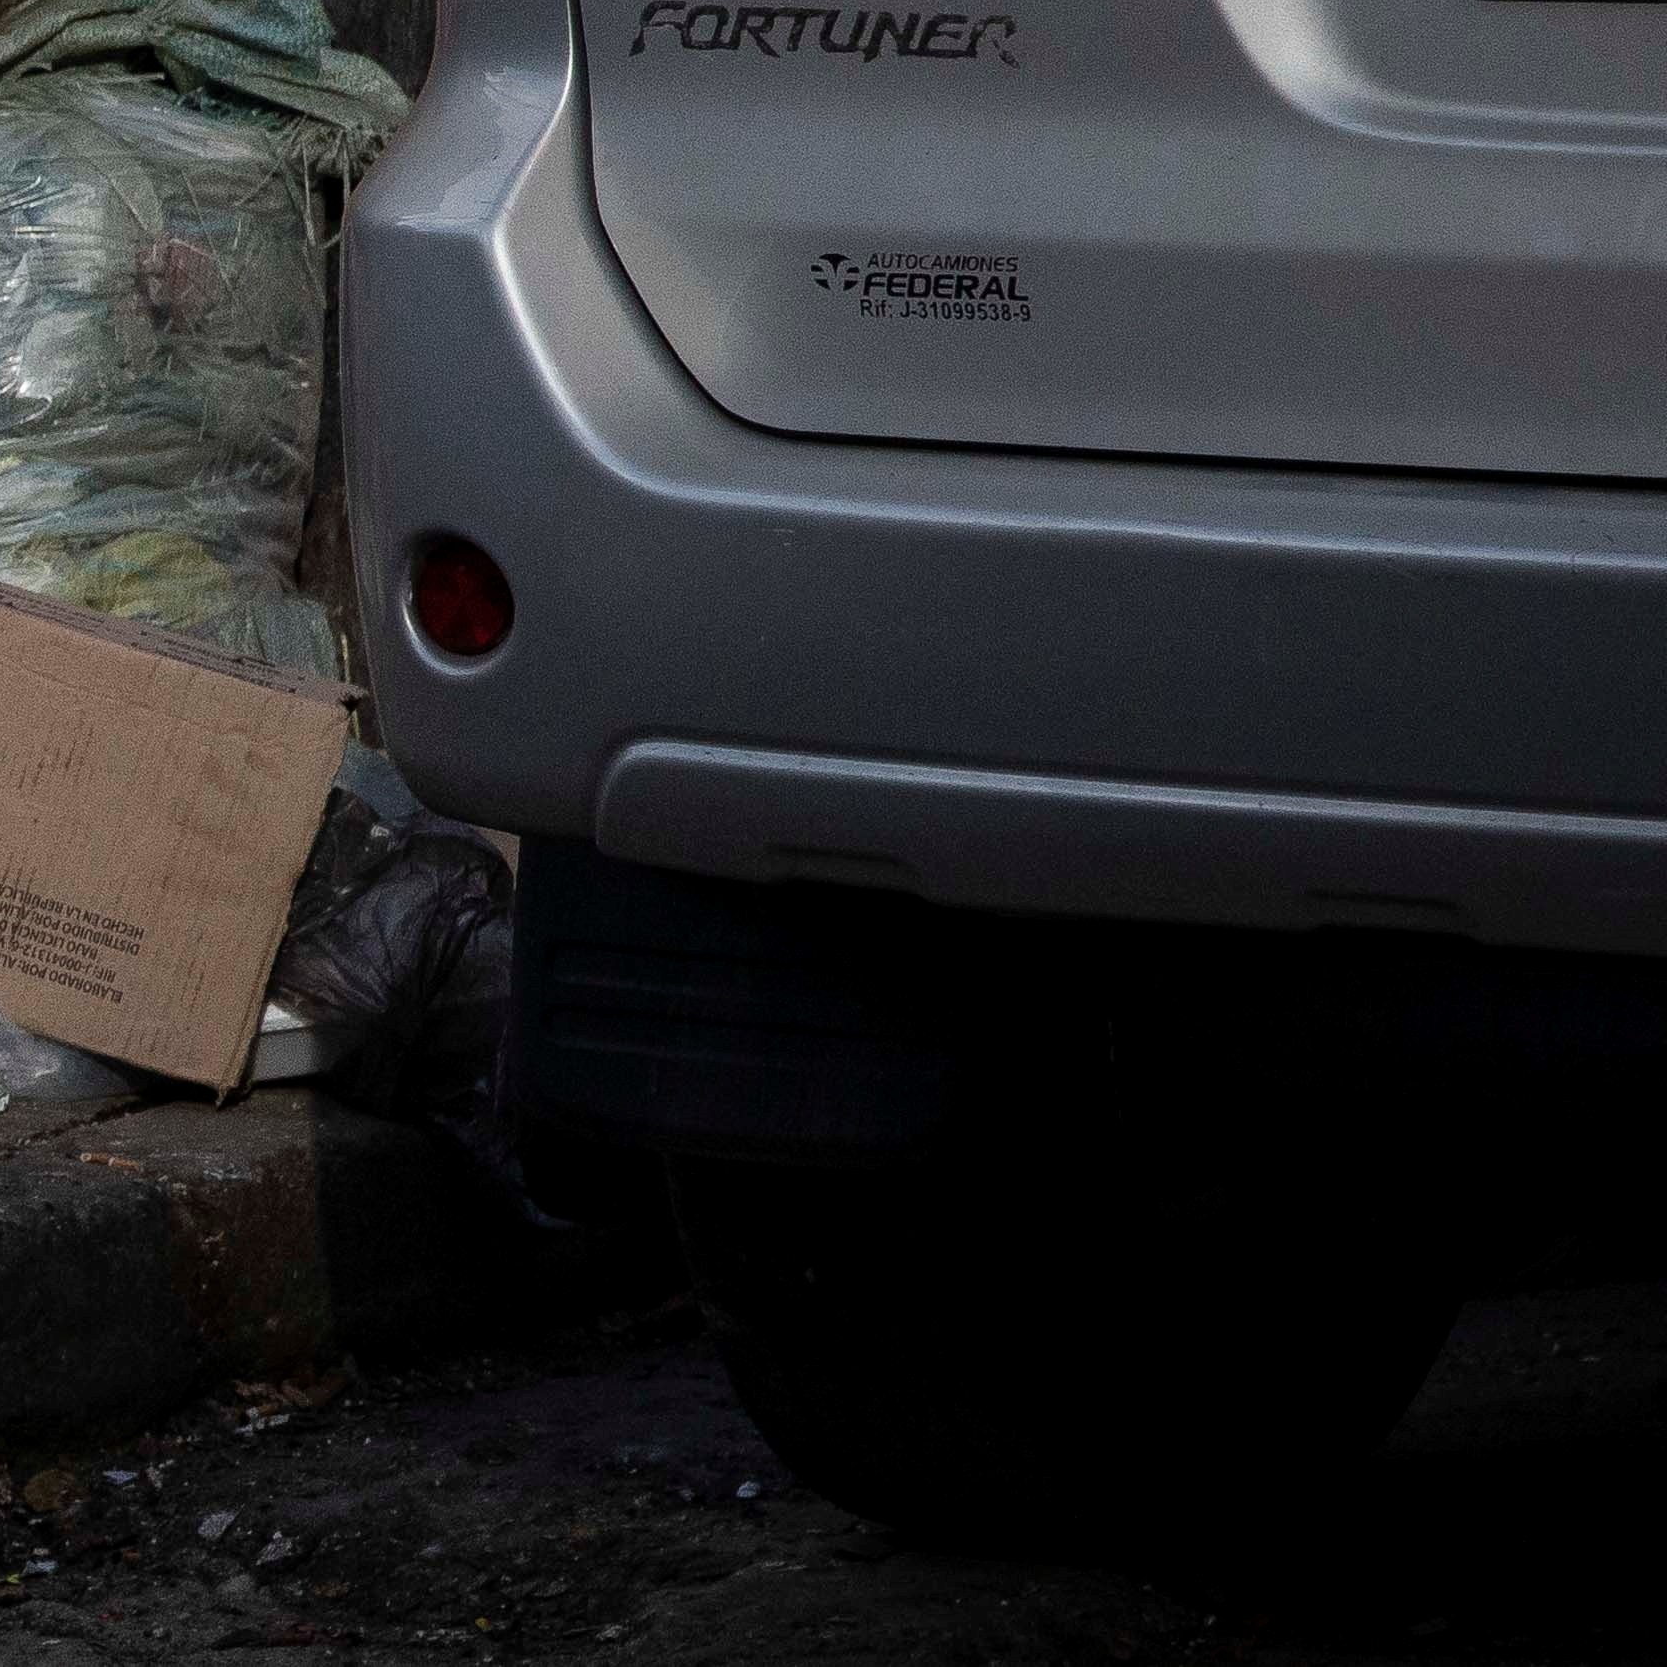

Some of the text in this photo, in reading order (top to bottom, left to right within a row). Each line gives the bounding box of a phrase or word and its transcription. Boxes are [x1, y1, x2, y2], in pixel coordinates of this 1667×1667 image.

[629, 0, 1020, 68] FORTUNER
[867, 253, 1019, 272] AUTOCAMIONES
[863, 272, 1030, 302] FEDERAL
[899, 302, 1032, 322] J-31099538-9
[64, 904, 81, 920] LA
[82, 909, 100, 926] EN
[9, 921, 65, 950] LICENCIA
[60, 920, 140, 956] DISTRIBUIDO
[99, 915, 144, 940] HECHO
[65, 938, 98, 960] BAJO
[16, 958, 47, 979] POR:
[47, 968, 123, 1004] ELABORADO
